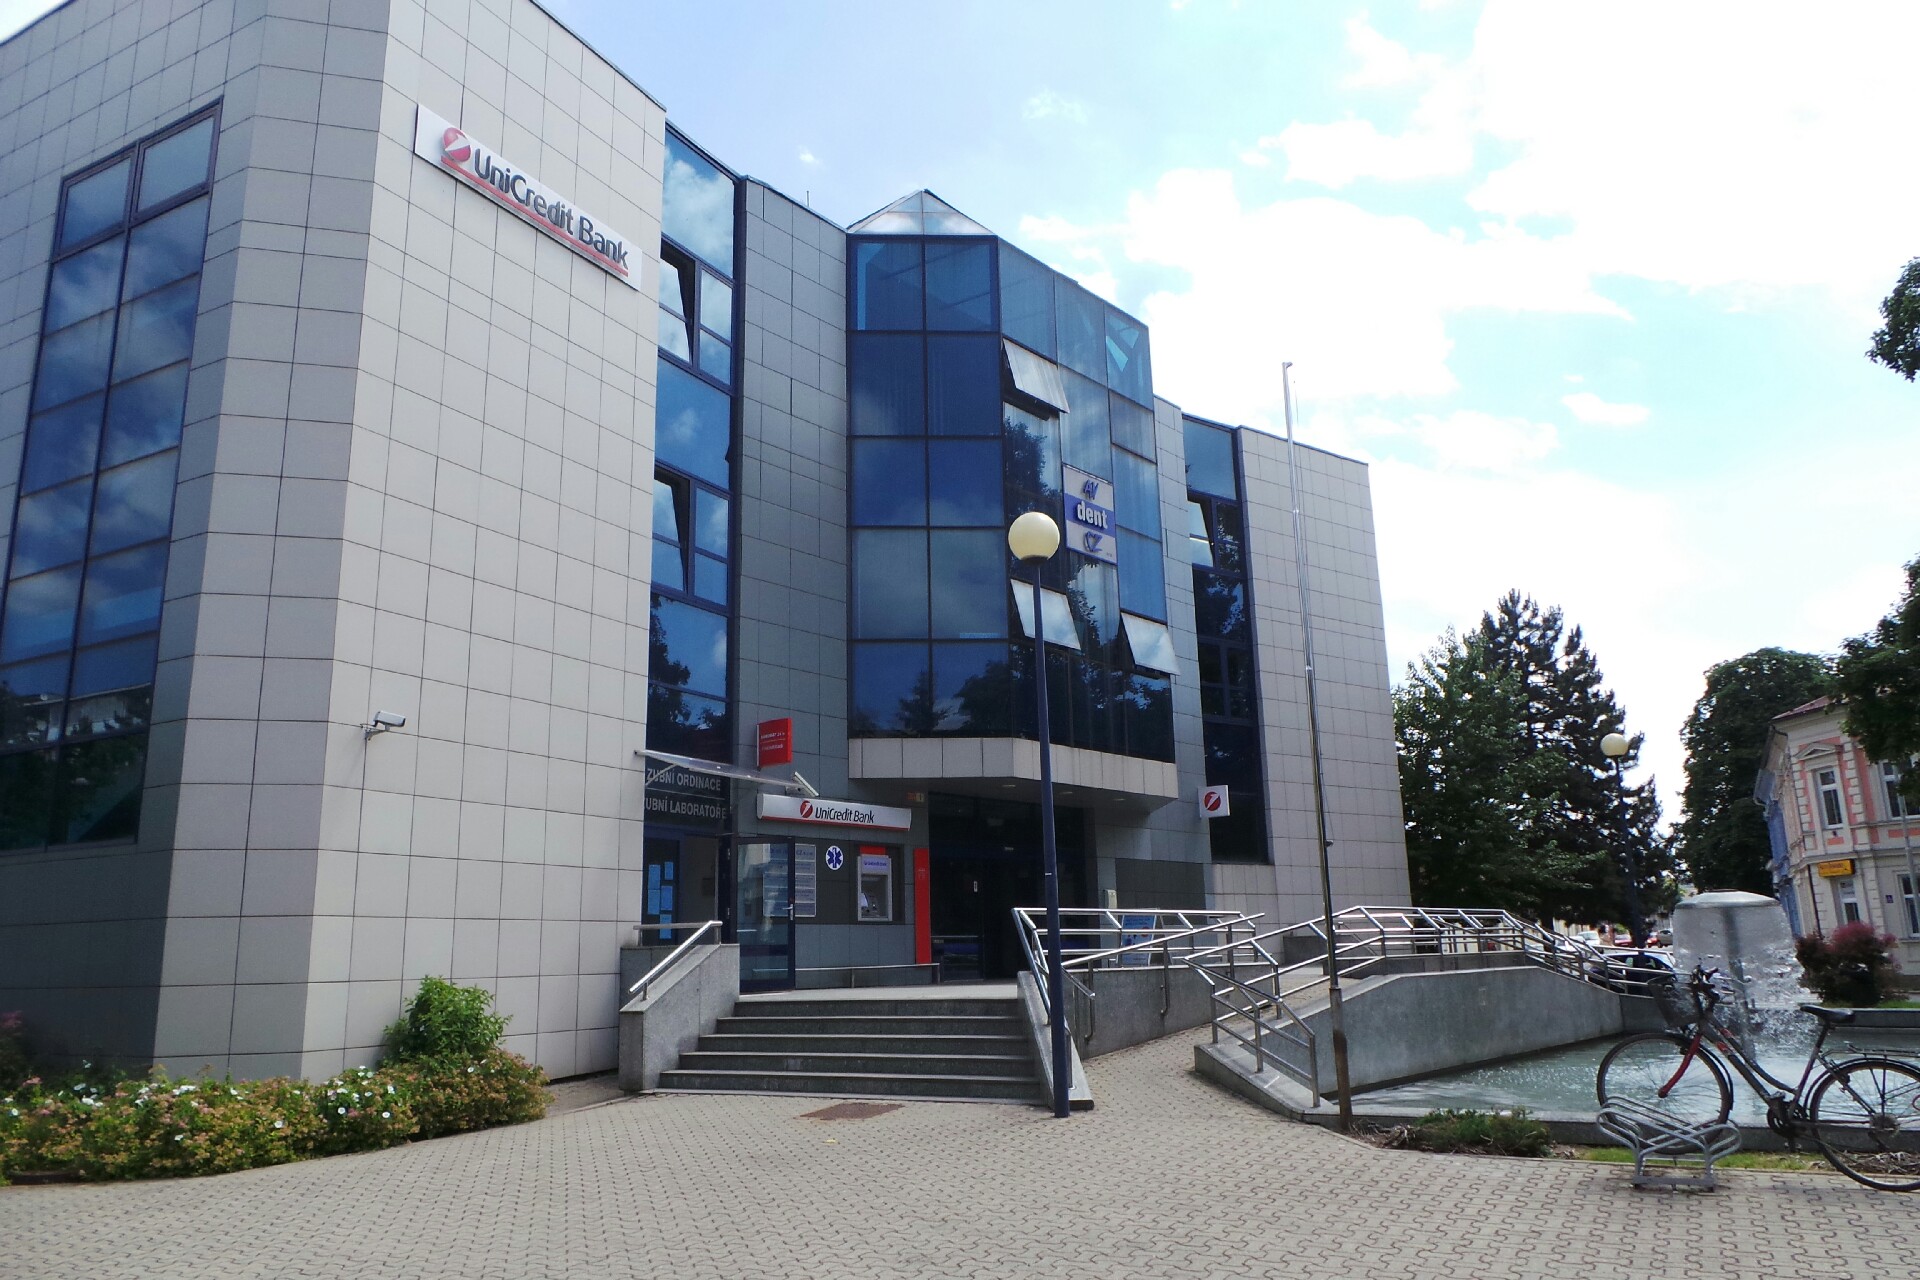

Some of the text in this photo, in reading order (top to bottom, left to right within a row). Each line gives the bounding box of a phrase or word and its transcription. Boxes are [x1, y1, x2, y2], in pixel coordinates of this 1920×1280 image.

[474, 148, 628, 270] UniCredit Bank
[1083, 479, 1099, 500] AV
[1077, 501, 1108, 529] dent
[647, 768, 721, 791] ZUBNÍ ORDINACE
[645, 796, 727, 819] UBNÍ LABORATOŘE
[815, 807, 875, 824] UniCredit Bank
